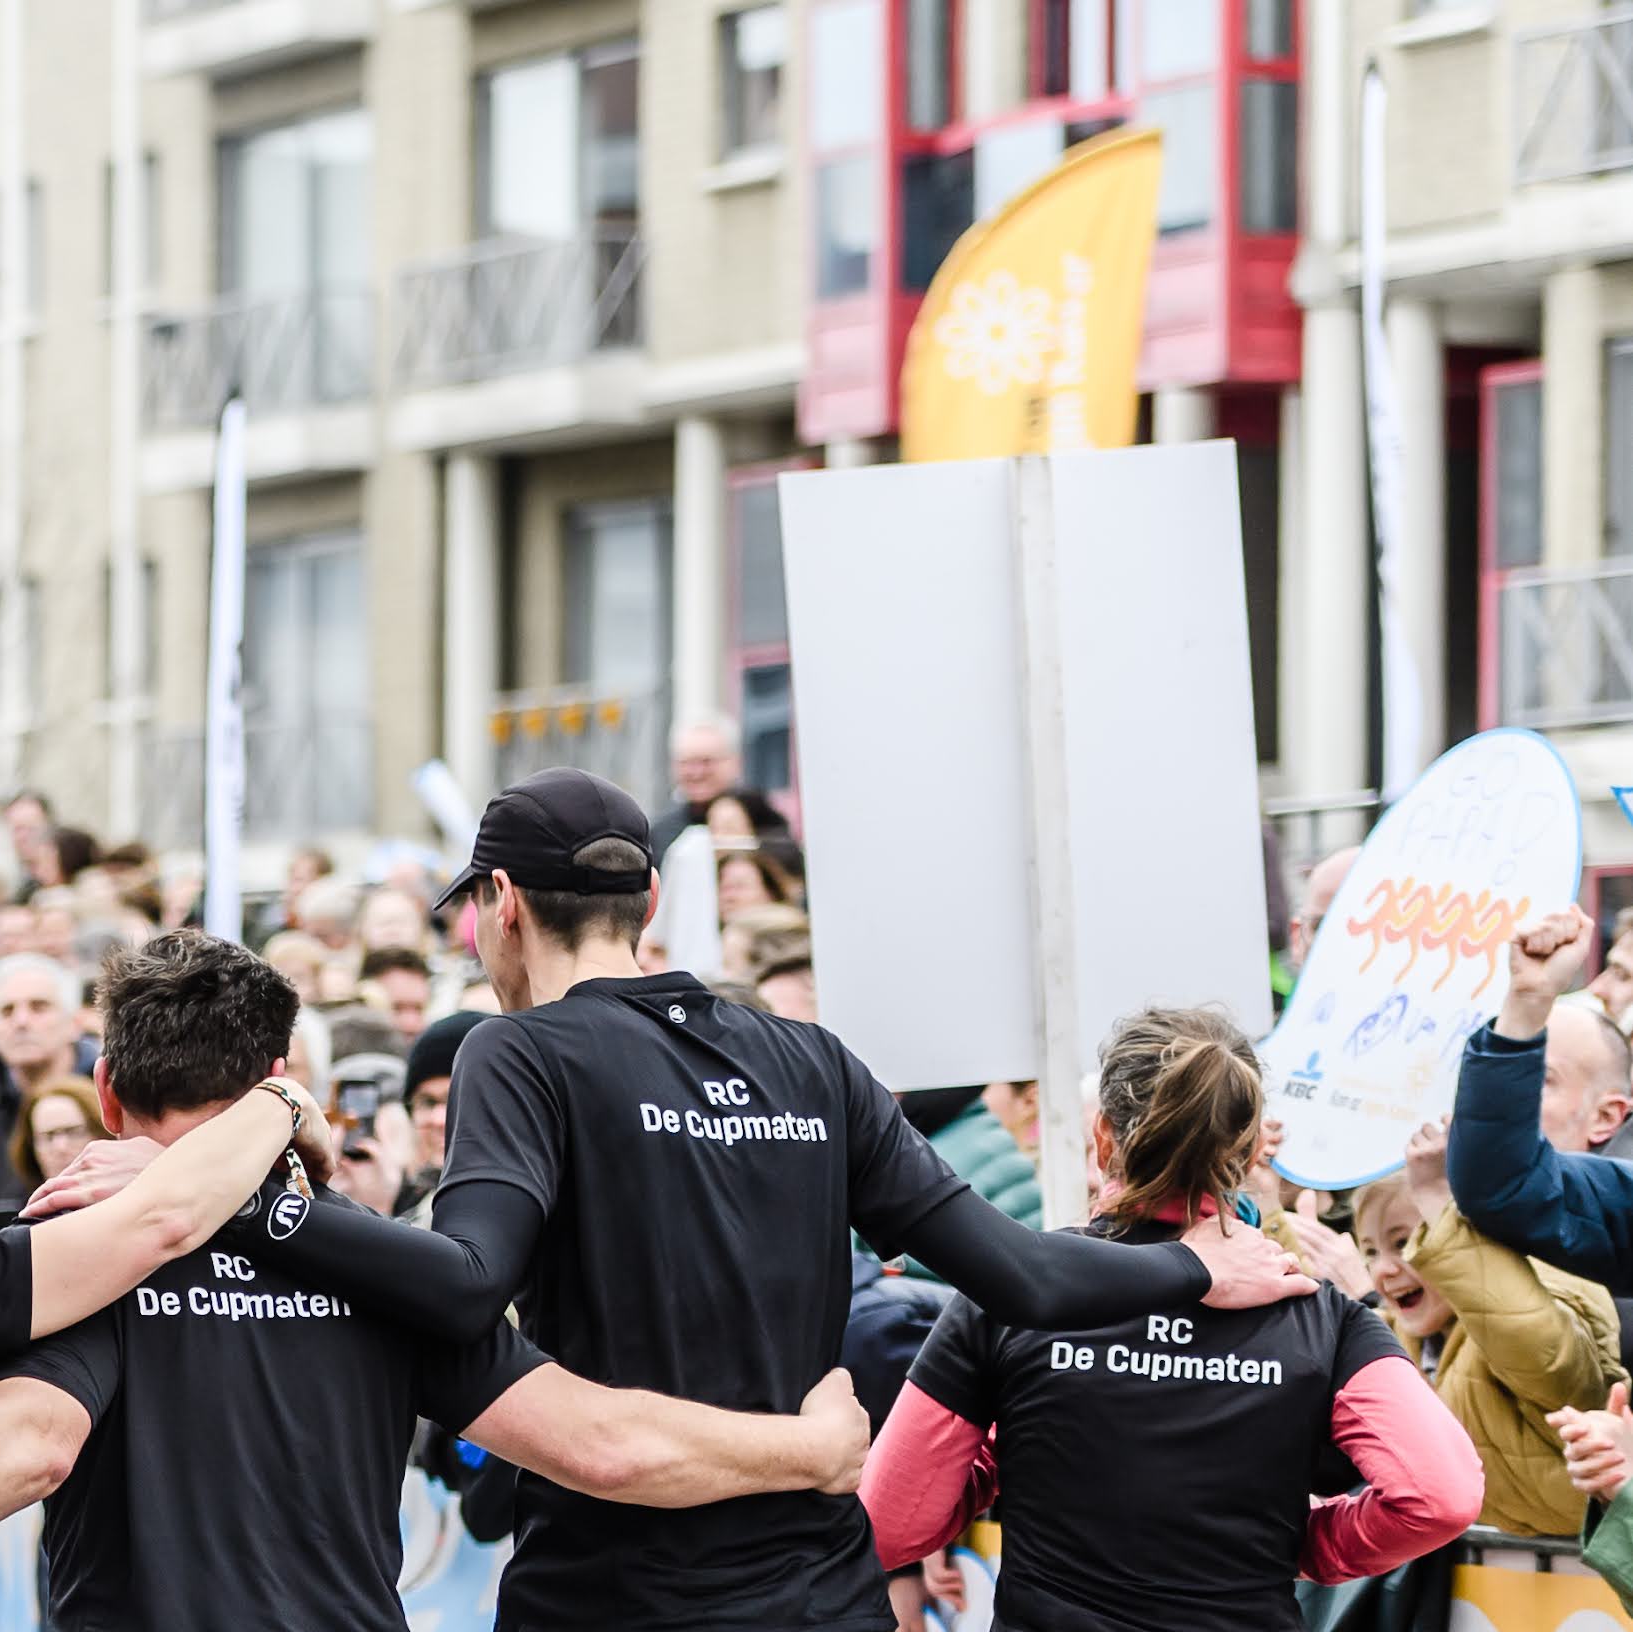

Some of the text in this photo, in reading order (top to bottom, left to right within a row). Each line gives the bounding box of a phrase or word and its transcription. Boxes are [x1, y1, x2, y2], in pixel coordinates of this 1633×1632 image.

[702, 1078, 750, 1106] RC
[1283, 1080, 1318, 1101] KBC
[639, 1103, 827, 1146] De Cupmaten
[210, 1252, 256, 1282] RC
[136, 1287, 181, 1316] De
[1146, 1314, 1194, 1344] RC
[1050, 1341, 1282, 1385] De Cupmaten
